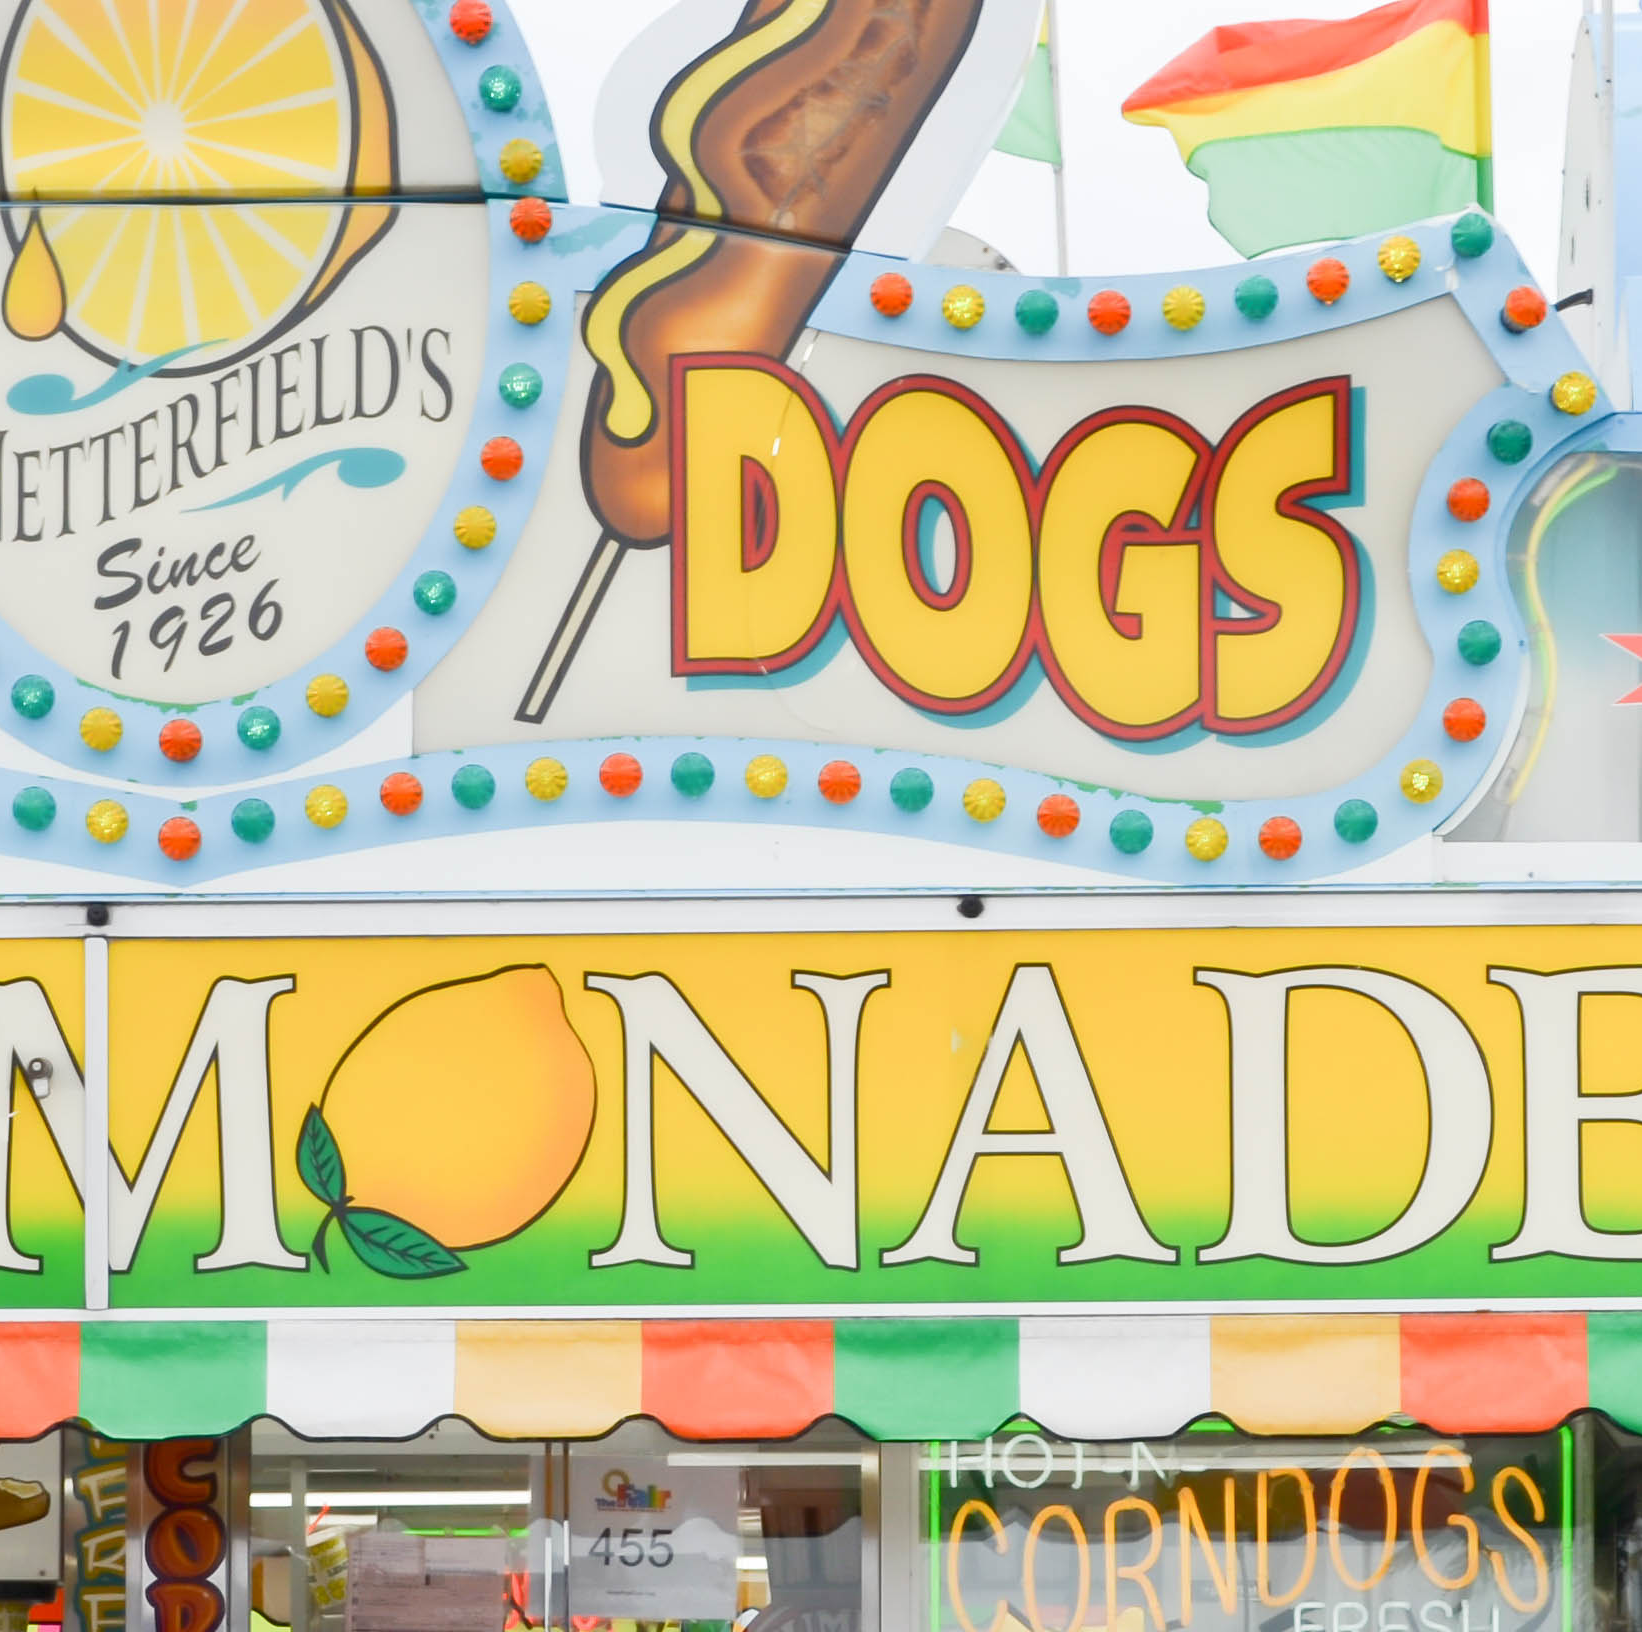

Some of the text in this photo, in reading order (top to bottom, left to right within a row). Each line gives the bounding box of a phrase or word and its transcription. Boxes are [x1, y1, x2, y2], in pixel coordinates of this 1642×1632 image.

[94, 533, 262, 610] Since
[669, 353, 1365, 748] DOGS
[112, 578, 284, 679] 1926
[589, 1527, 674, 1568] 455
